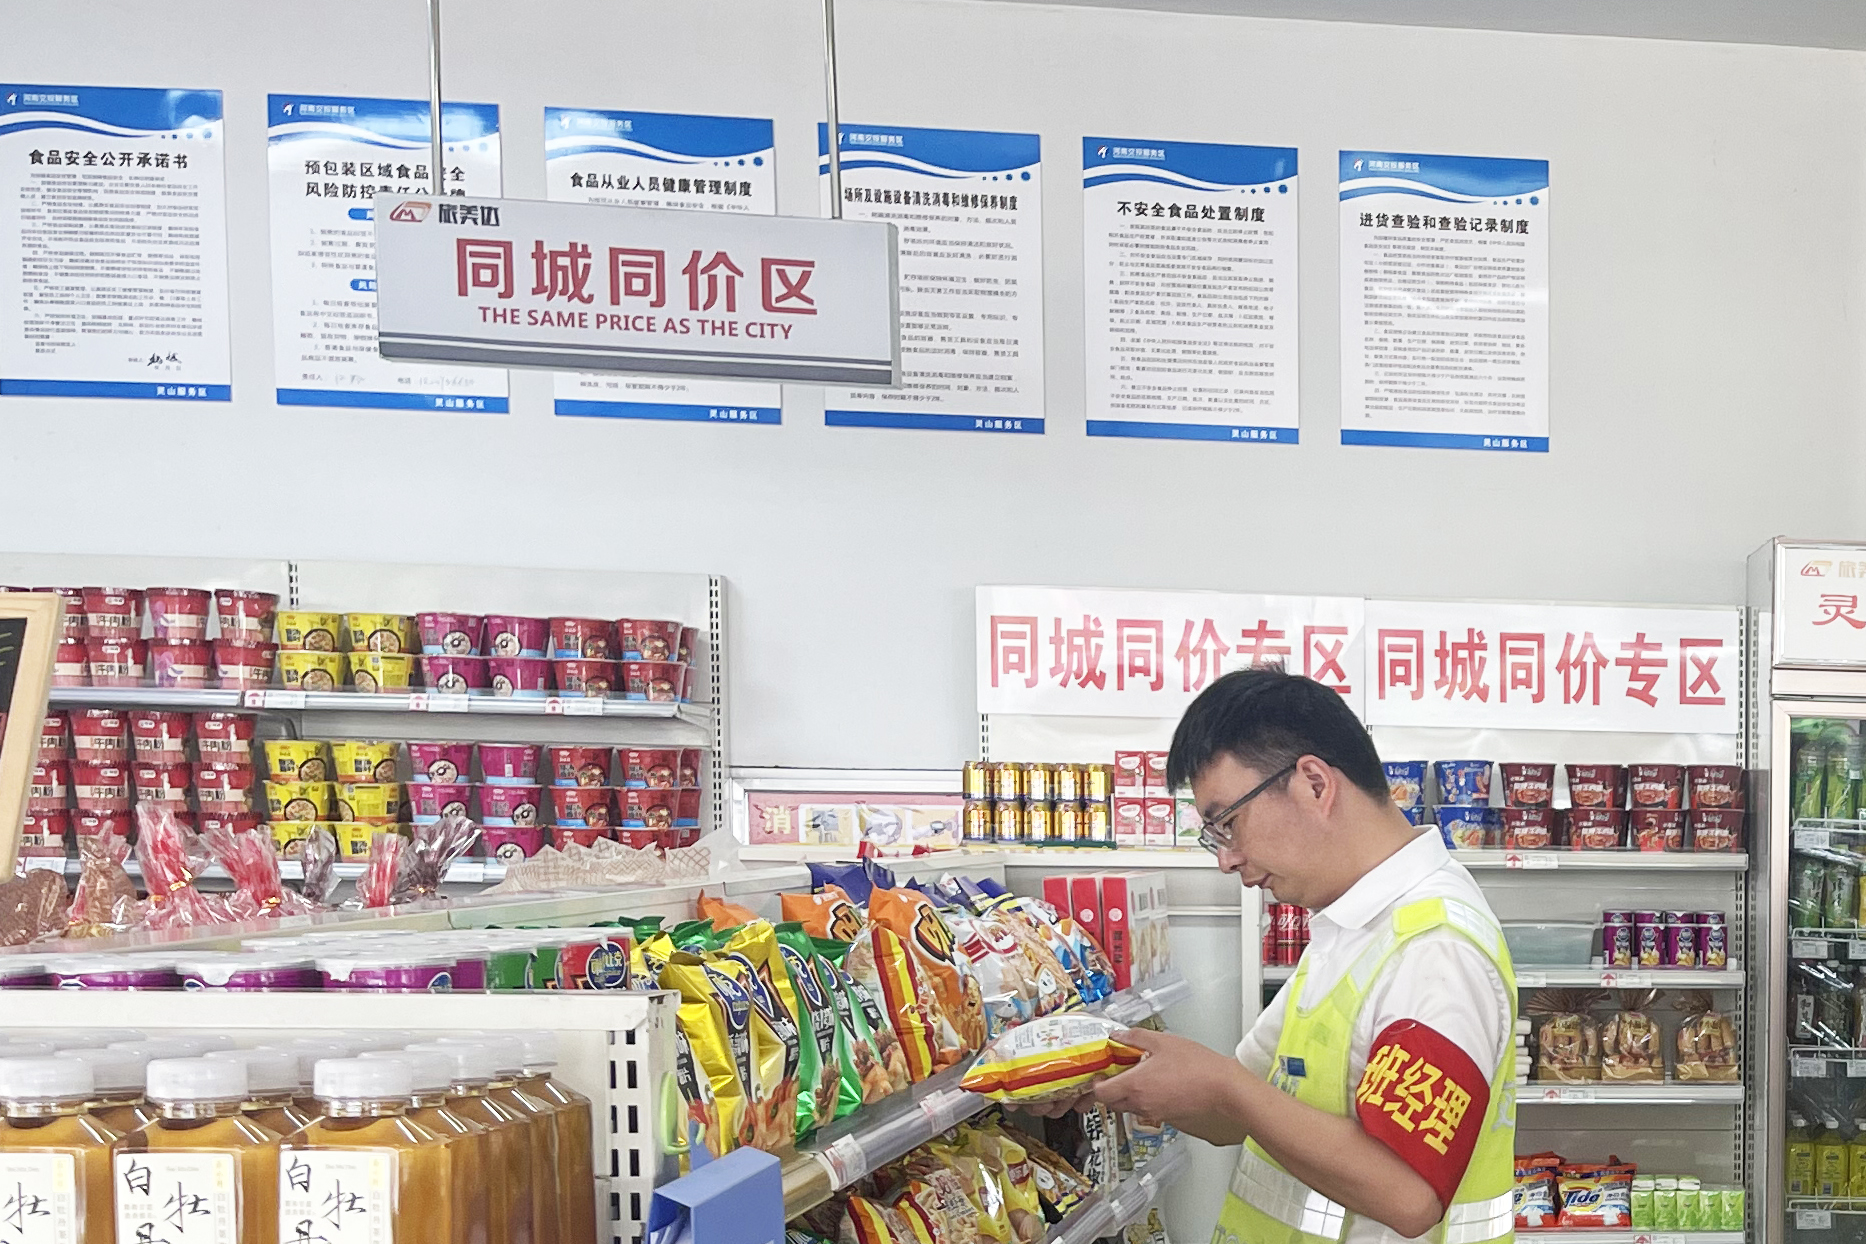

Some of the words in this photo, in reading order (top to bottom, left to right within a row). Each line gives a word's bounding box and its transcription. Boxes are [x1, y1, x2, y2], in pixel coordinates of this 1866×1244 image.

[28, 149, 188, 170] 食品安全公开承诺书
[304, 160, 466, 183] 预包装区域食品全
[570, 171, 752, 197] 食品从业人员健康管理制度
[844, 187, 1018, 211] 场所及设施设备清洗消毒和维修保养制度
[1117, 200, 1266, 223] 不安全食品处置制度
[1359, 212, 1530, 236] 进货查验和查验记录制度
[456, 237, 818, 315] 同城同价区
[478, 305, 521, 326] THE
[527, 310, 588, 330] SAME
[596, 313, 657, 334] PRICE
[664, 317, 691, 336] AS
[697, 318, 739, 338] THE
[745, 321, 793, 341] CITY
[156, 385, 208, 398] 灵山服务区
[709, 408, 759, 422] 灵山服务区
[975, 418, 1023, 431] 灵山服务区
[1231, 428, 1278, 441] 灵山服务区
[1483, 437, 1529, 450] 灵山服务区
[989, 613, 1352, 696] 同城同价专区
[1377, 627, 1727, 709] 同城同价专区
